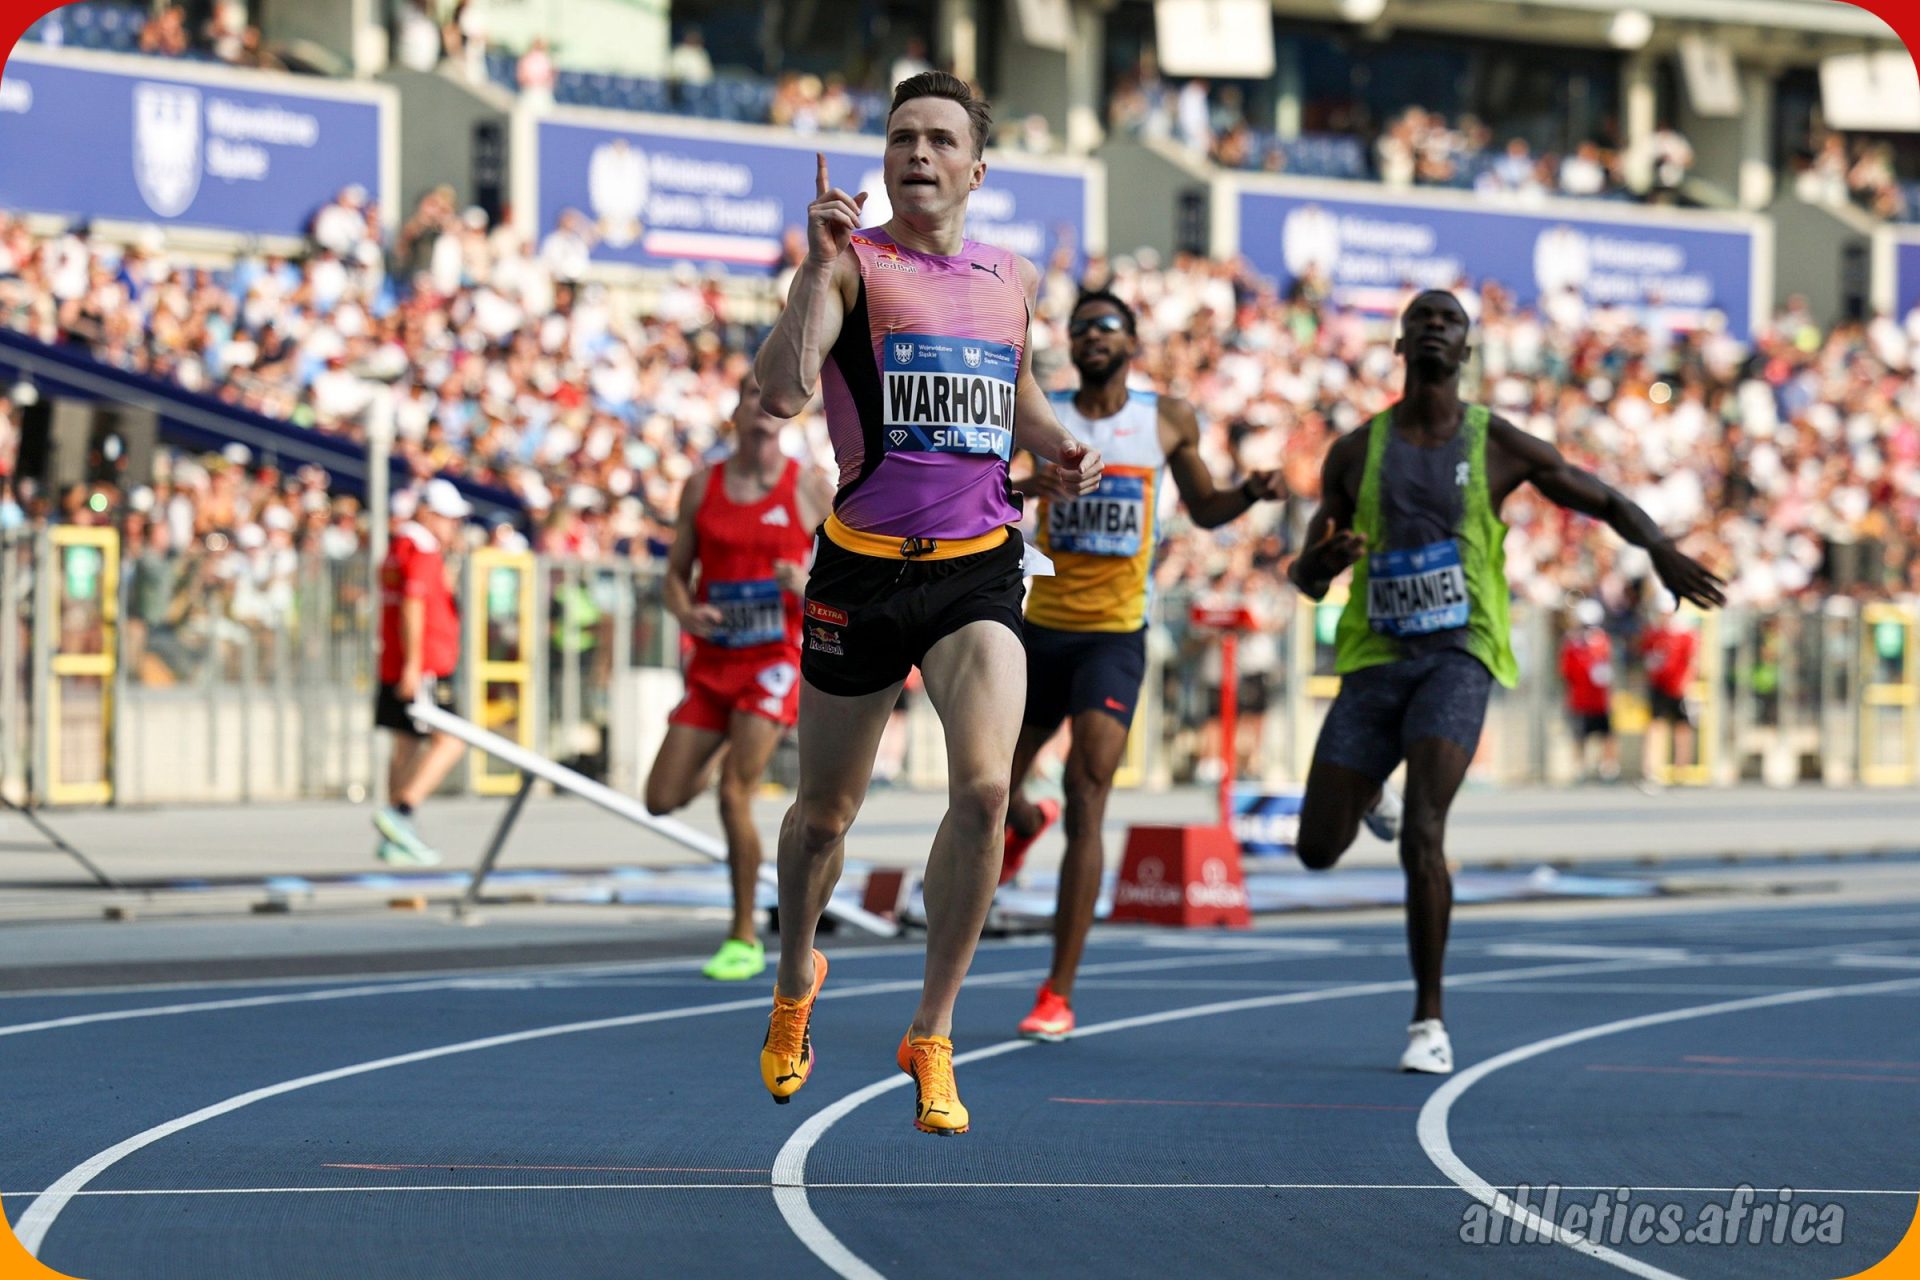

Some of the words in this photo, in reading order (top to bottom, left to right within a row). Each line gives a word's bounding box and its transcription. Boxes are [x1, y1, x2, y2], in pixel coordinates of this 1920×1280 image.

[889, 374, 1012, 432] WARHOLM
[933, 430, 1004, 449] SILESIA
[1051, 501, 1138, 534] SAMBA
[1371, 570, 1463, 617] NATHANIEL
[817, 608, 843, 620] EXTRA
